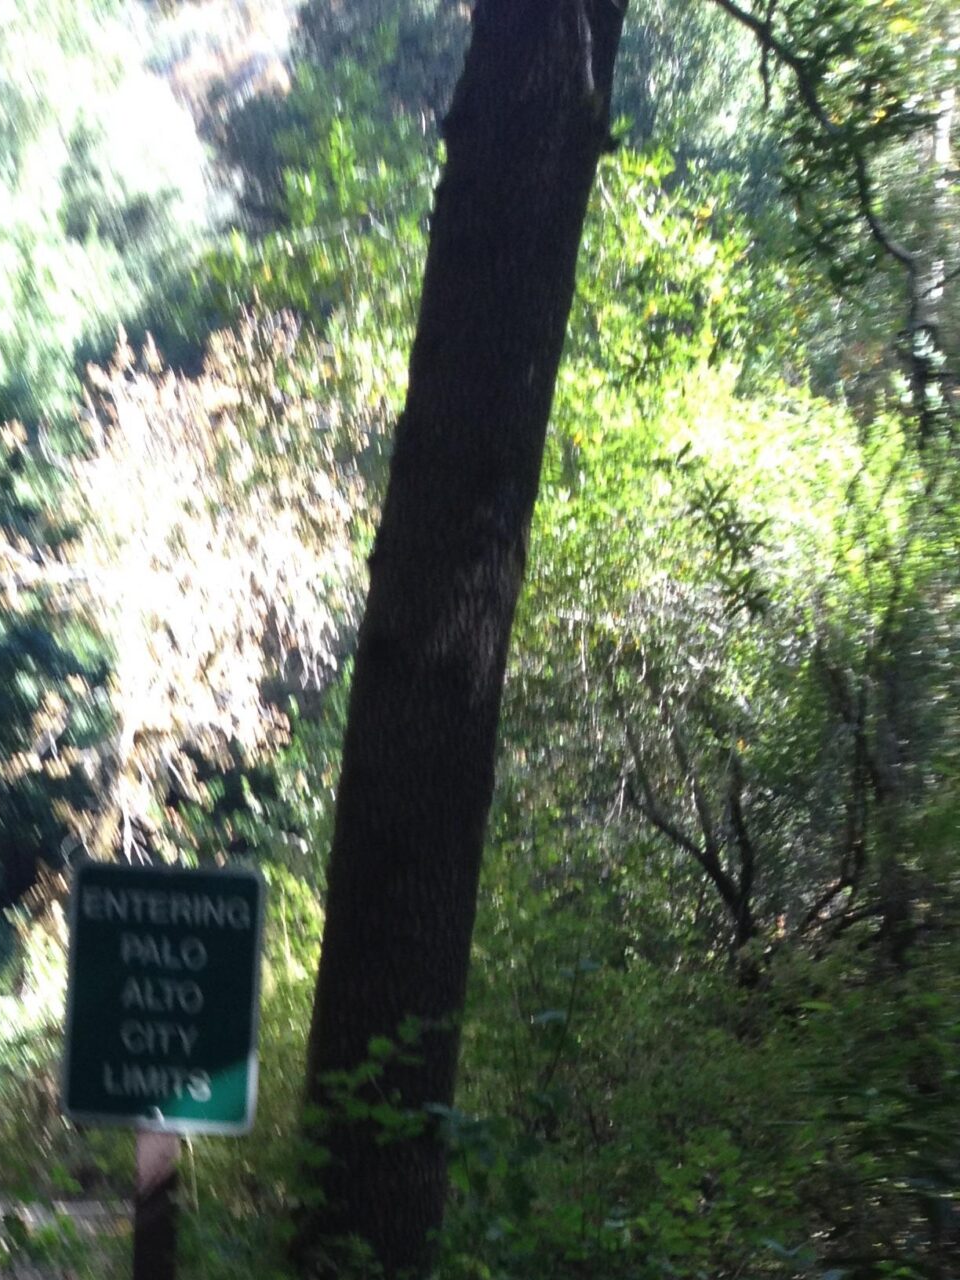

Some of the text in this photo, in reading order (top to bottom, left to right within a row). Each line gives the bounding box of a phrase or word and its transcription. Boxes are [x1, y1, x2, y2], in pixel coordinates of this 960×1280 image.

[83, 886, 250, 928] ENTERING
[120, 933, 207, 969] PALO
[121, 976, 204, 1013] ALTO
[120, 1018, 199, 1054] CITY
[104, 1059, 211, 1102] LIMITS
